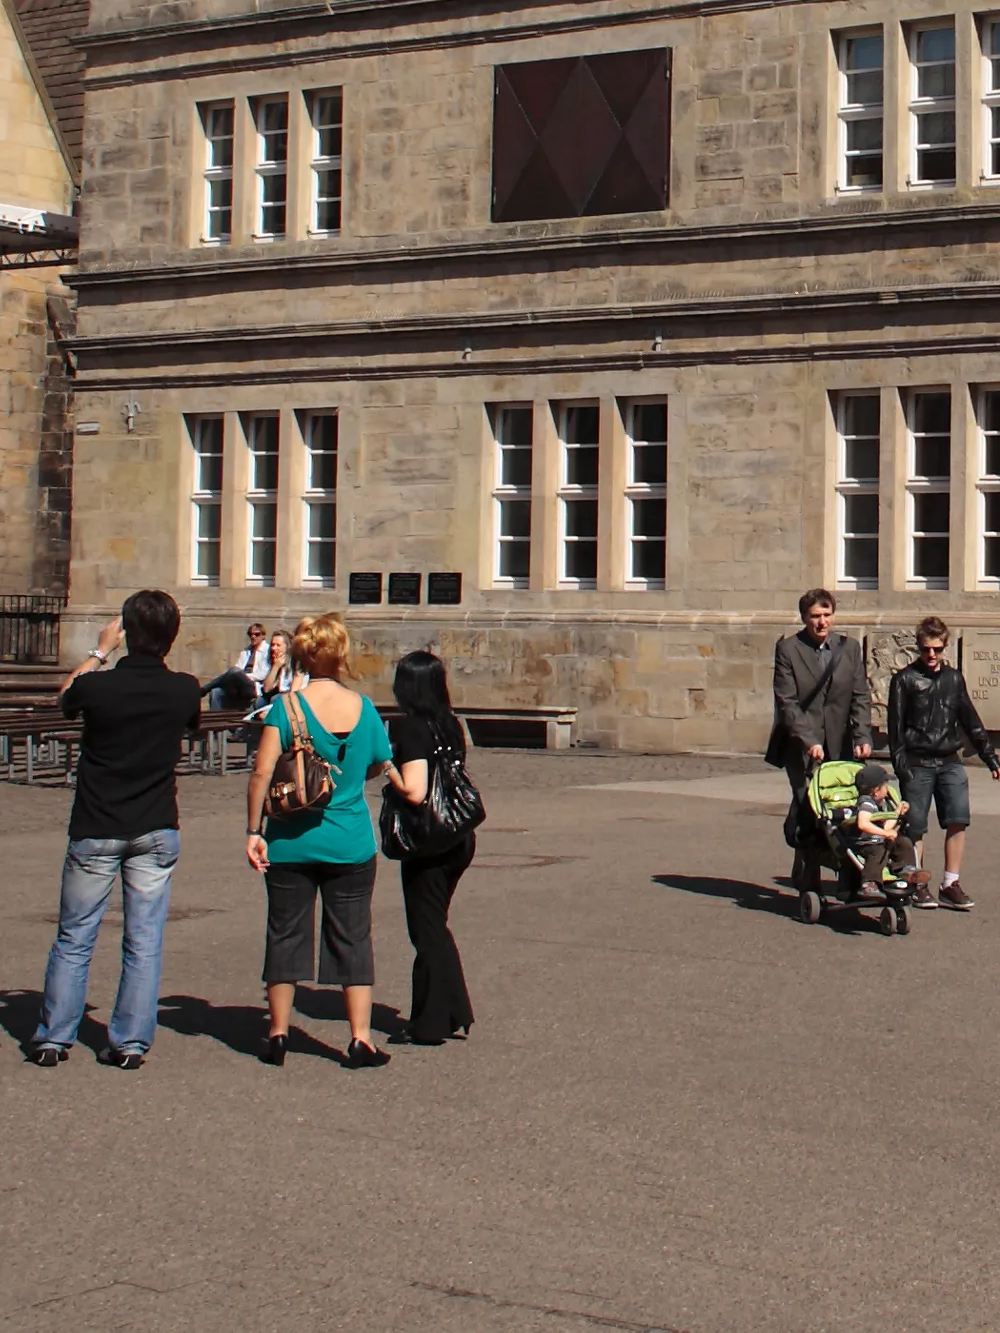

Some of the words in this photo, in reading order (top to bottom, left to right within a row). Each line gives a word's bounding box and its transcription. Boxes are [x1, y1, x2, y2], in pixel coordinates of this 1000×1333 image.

[973, 651, 991, 661] DER
[978, 677, 999, 687] UND
[972, 690, 989, 700] DIE
